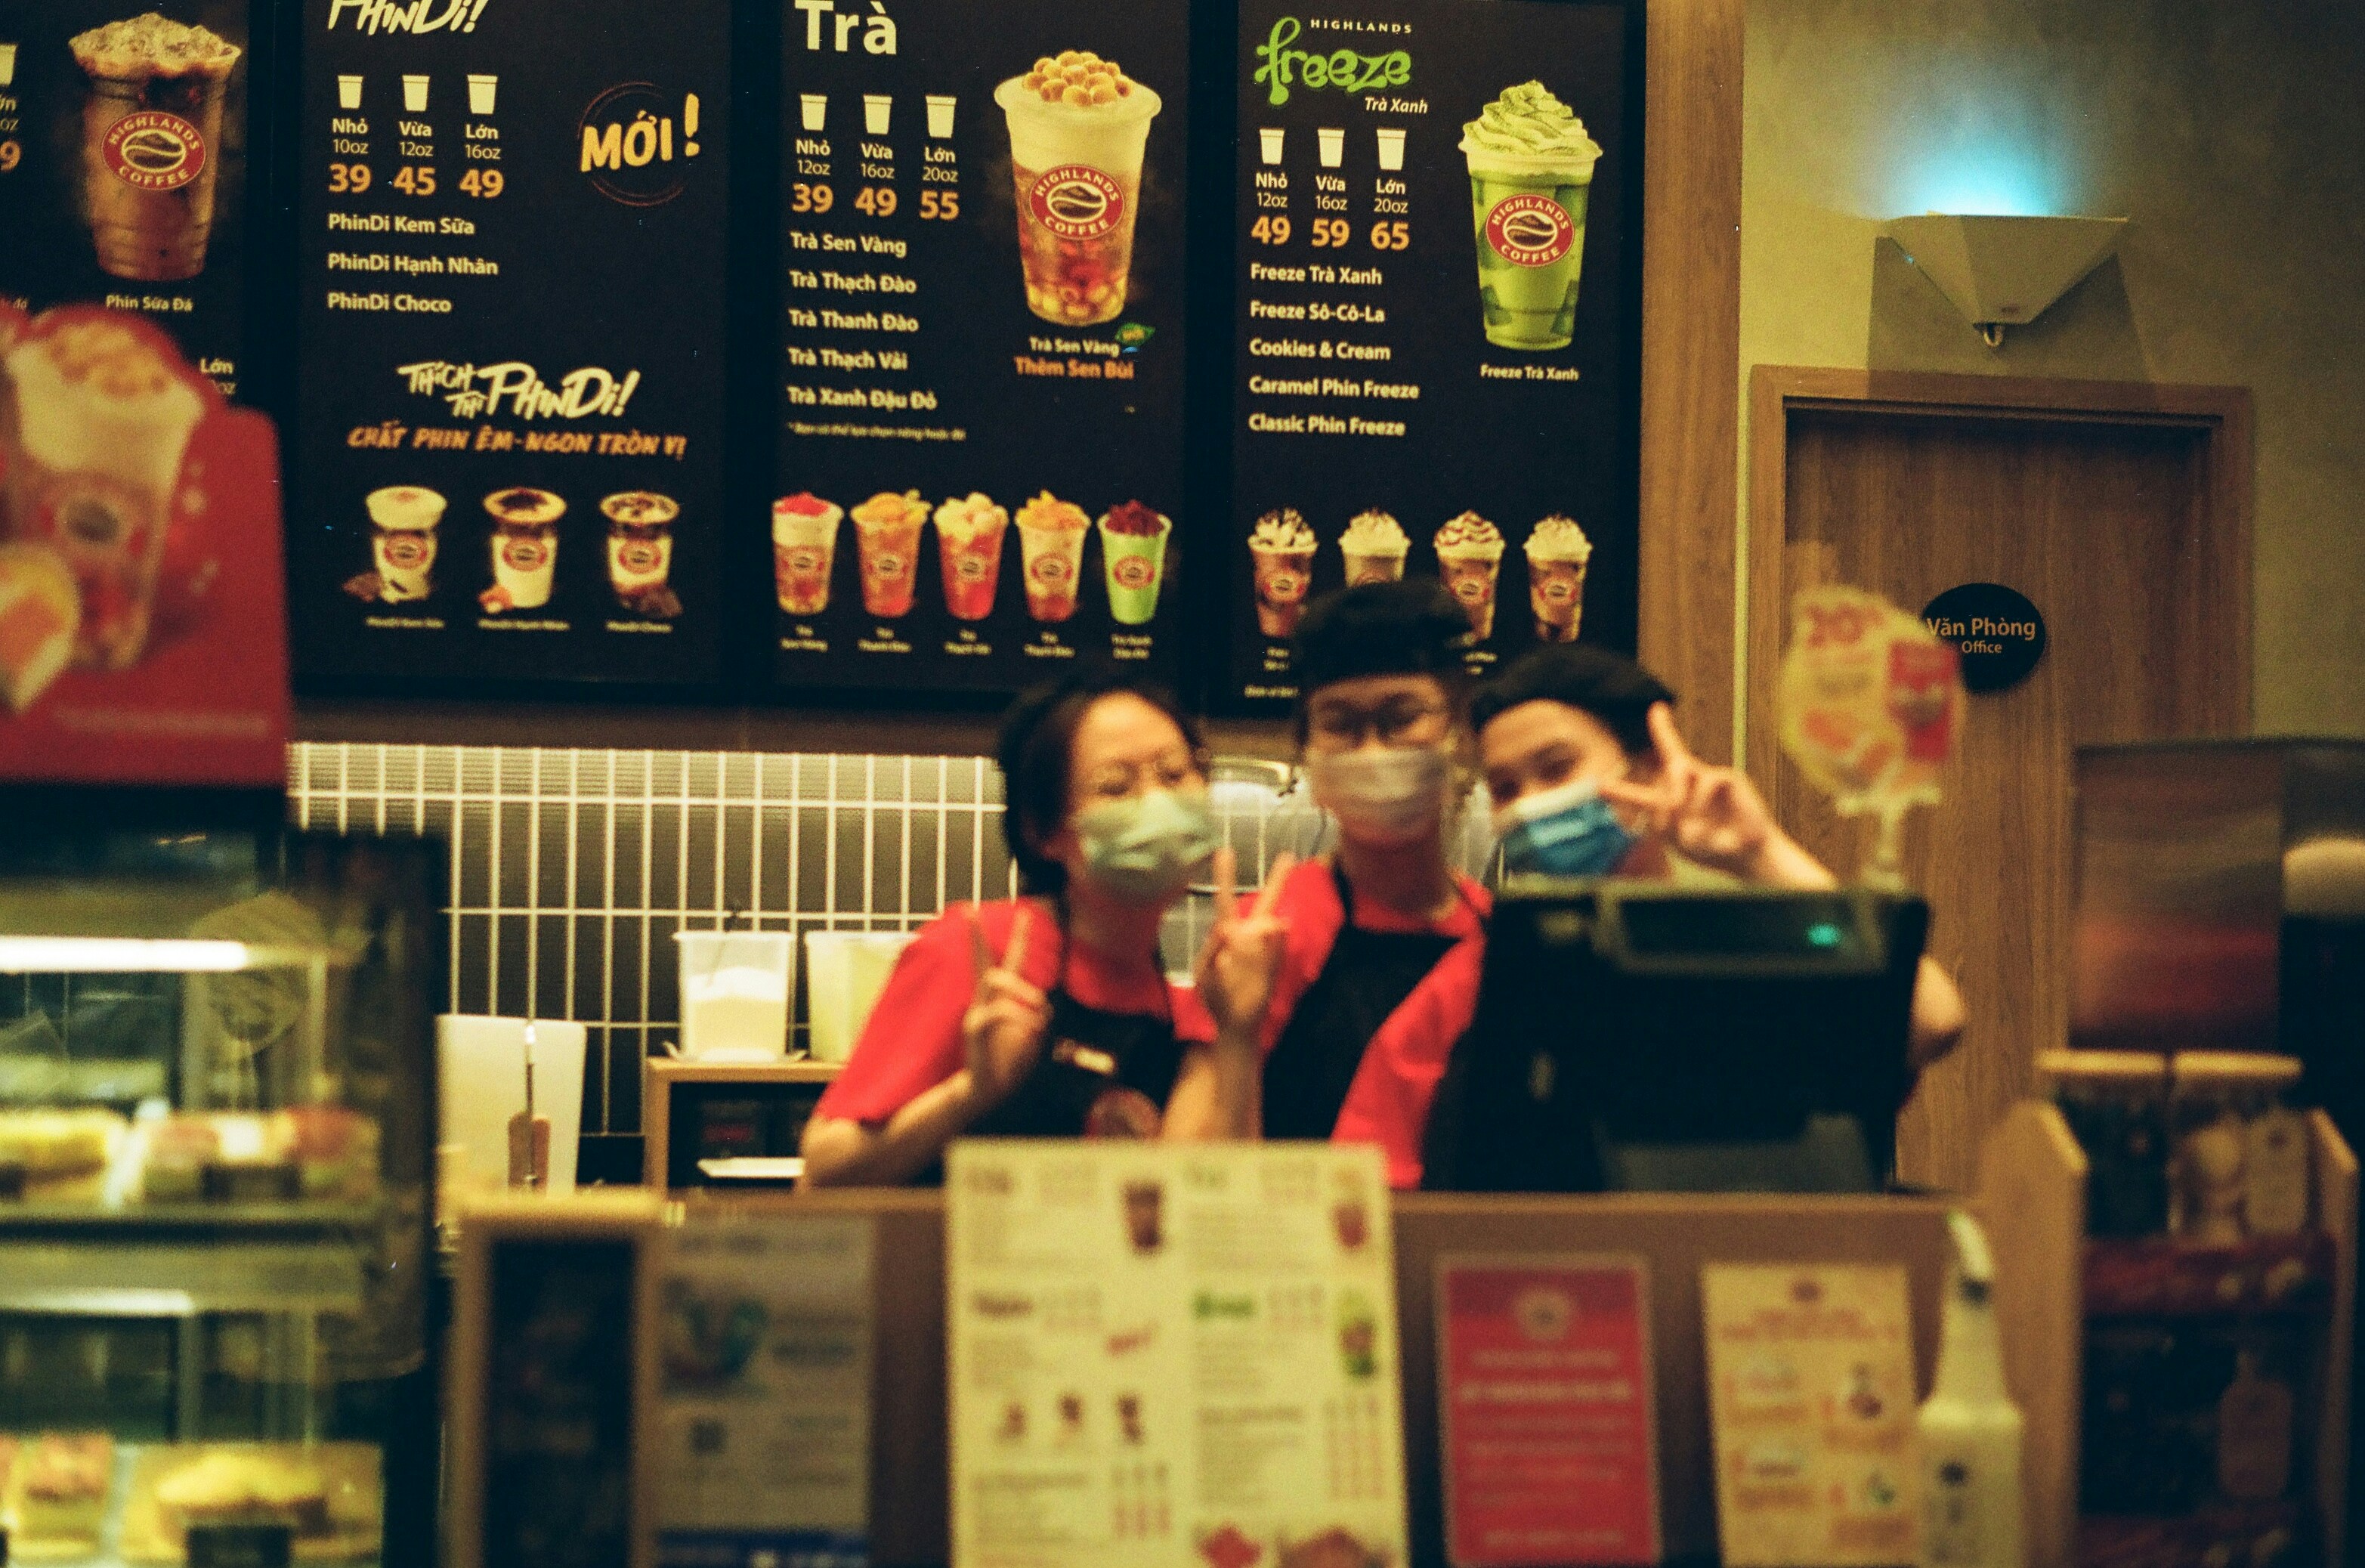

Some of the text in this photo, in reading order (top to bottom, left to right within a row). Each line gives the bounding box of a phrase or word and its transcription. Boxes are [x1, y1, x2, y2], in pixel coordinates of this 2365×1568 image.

[794, 0, 898, 55] Trà
[1310, 19, 1411, 34] HIGHLANDS
[1254, 16, 1413, 104] freeze
[1365, 96, 1428, 114] Trà Xanh
[107, 116, 200, 150] HIGHLANDS
[332, 118, 499, 140] Nhỏ Vừa Lớn
[0, 140, 22, 173] 9
[332, 138, 501, 160] 10oz 12oz 16oz
[796, 139, 956, 163] Nhỏ Vừa Lớn
[117, 165, 190, 186] COFFEE
[329, 163, 504, 198] 39 45 49
[797, 159, 959, 183] 12oz 16oz 20oz
[1035, 169, 1120, 203] HIGHLANDS
[1255, 172, 1406, 195] Nhỏ Vừa Lớn
[792, 183, 960, 220] 39 49 55
[1257, 191, 1408, 214] 12oz 16oz 20oz
[328, 212, 475, 235] PhinDi Kem Sữa
[1491, 200, 1569, 231] HIGHLANDS
[1044, 218, 1109, 237] COFFEE
[1251, 215, 1410, 250] 49 59 65
[790, 231, 907, 258] Trà Sen Vàng
[1500, 246, 1561, 263] COFFEE
[327, 252, 499, 277] PhinDi Hạnh Nhân
[1251, 262, 1383, 285] Freeze Trà Xanh
[789, 270, 917, 294] Trà Thạch Đào
[105, 294, 193, 311] Phin Sữa Đá
[327, 292, 452, 313] PhinDi Choco
[1250, 300, 1386, 323] Freeze Sô-Cô-La
[788, 308, 920, 332] Trà Thanh Đào
[1029, 336, 1120, 358] Trà Sen Vàng
[1249, 338, 1391, 360] Cookies & Cream
[199, 358, 233, 376] Lớn
[787, 347, 818, 366] Trà
[820, 348, 876, 371] Thạch
[1014, 356, 1065, 376] Thêm
[1068, 358, 1102, 378] Sen
[1480, 363, 1579, 380] Freeze Trà Xanh
[787, 385, 817, 405] Trà
[820, 388, 867, 407] Xanh
[868, 389, 908, 410] Đậu
[1249, 375, 1420, 399] Caramel Phin Freeze
[1248, 413, 1405, 436] Classic Phin Freeze
[413, 428, 470, 449] PHIN
[598, 430, 660, 455] TRÒN
[1925, 616, 2037, 641] Văn Phòng
[1961, 639, 2002, 654] Office
